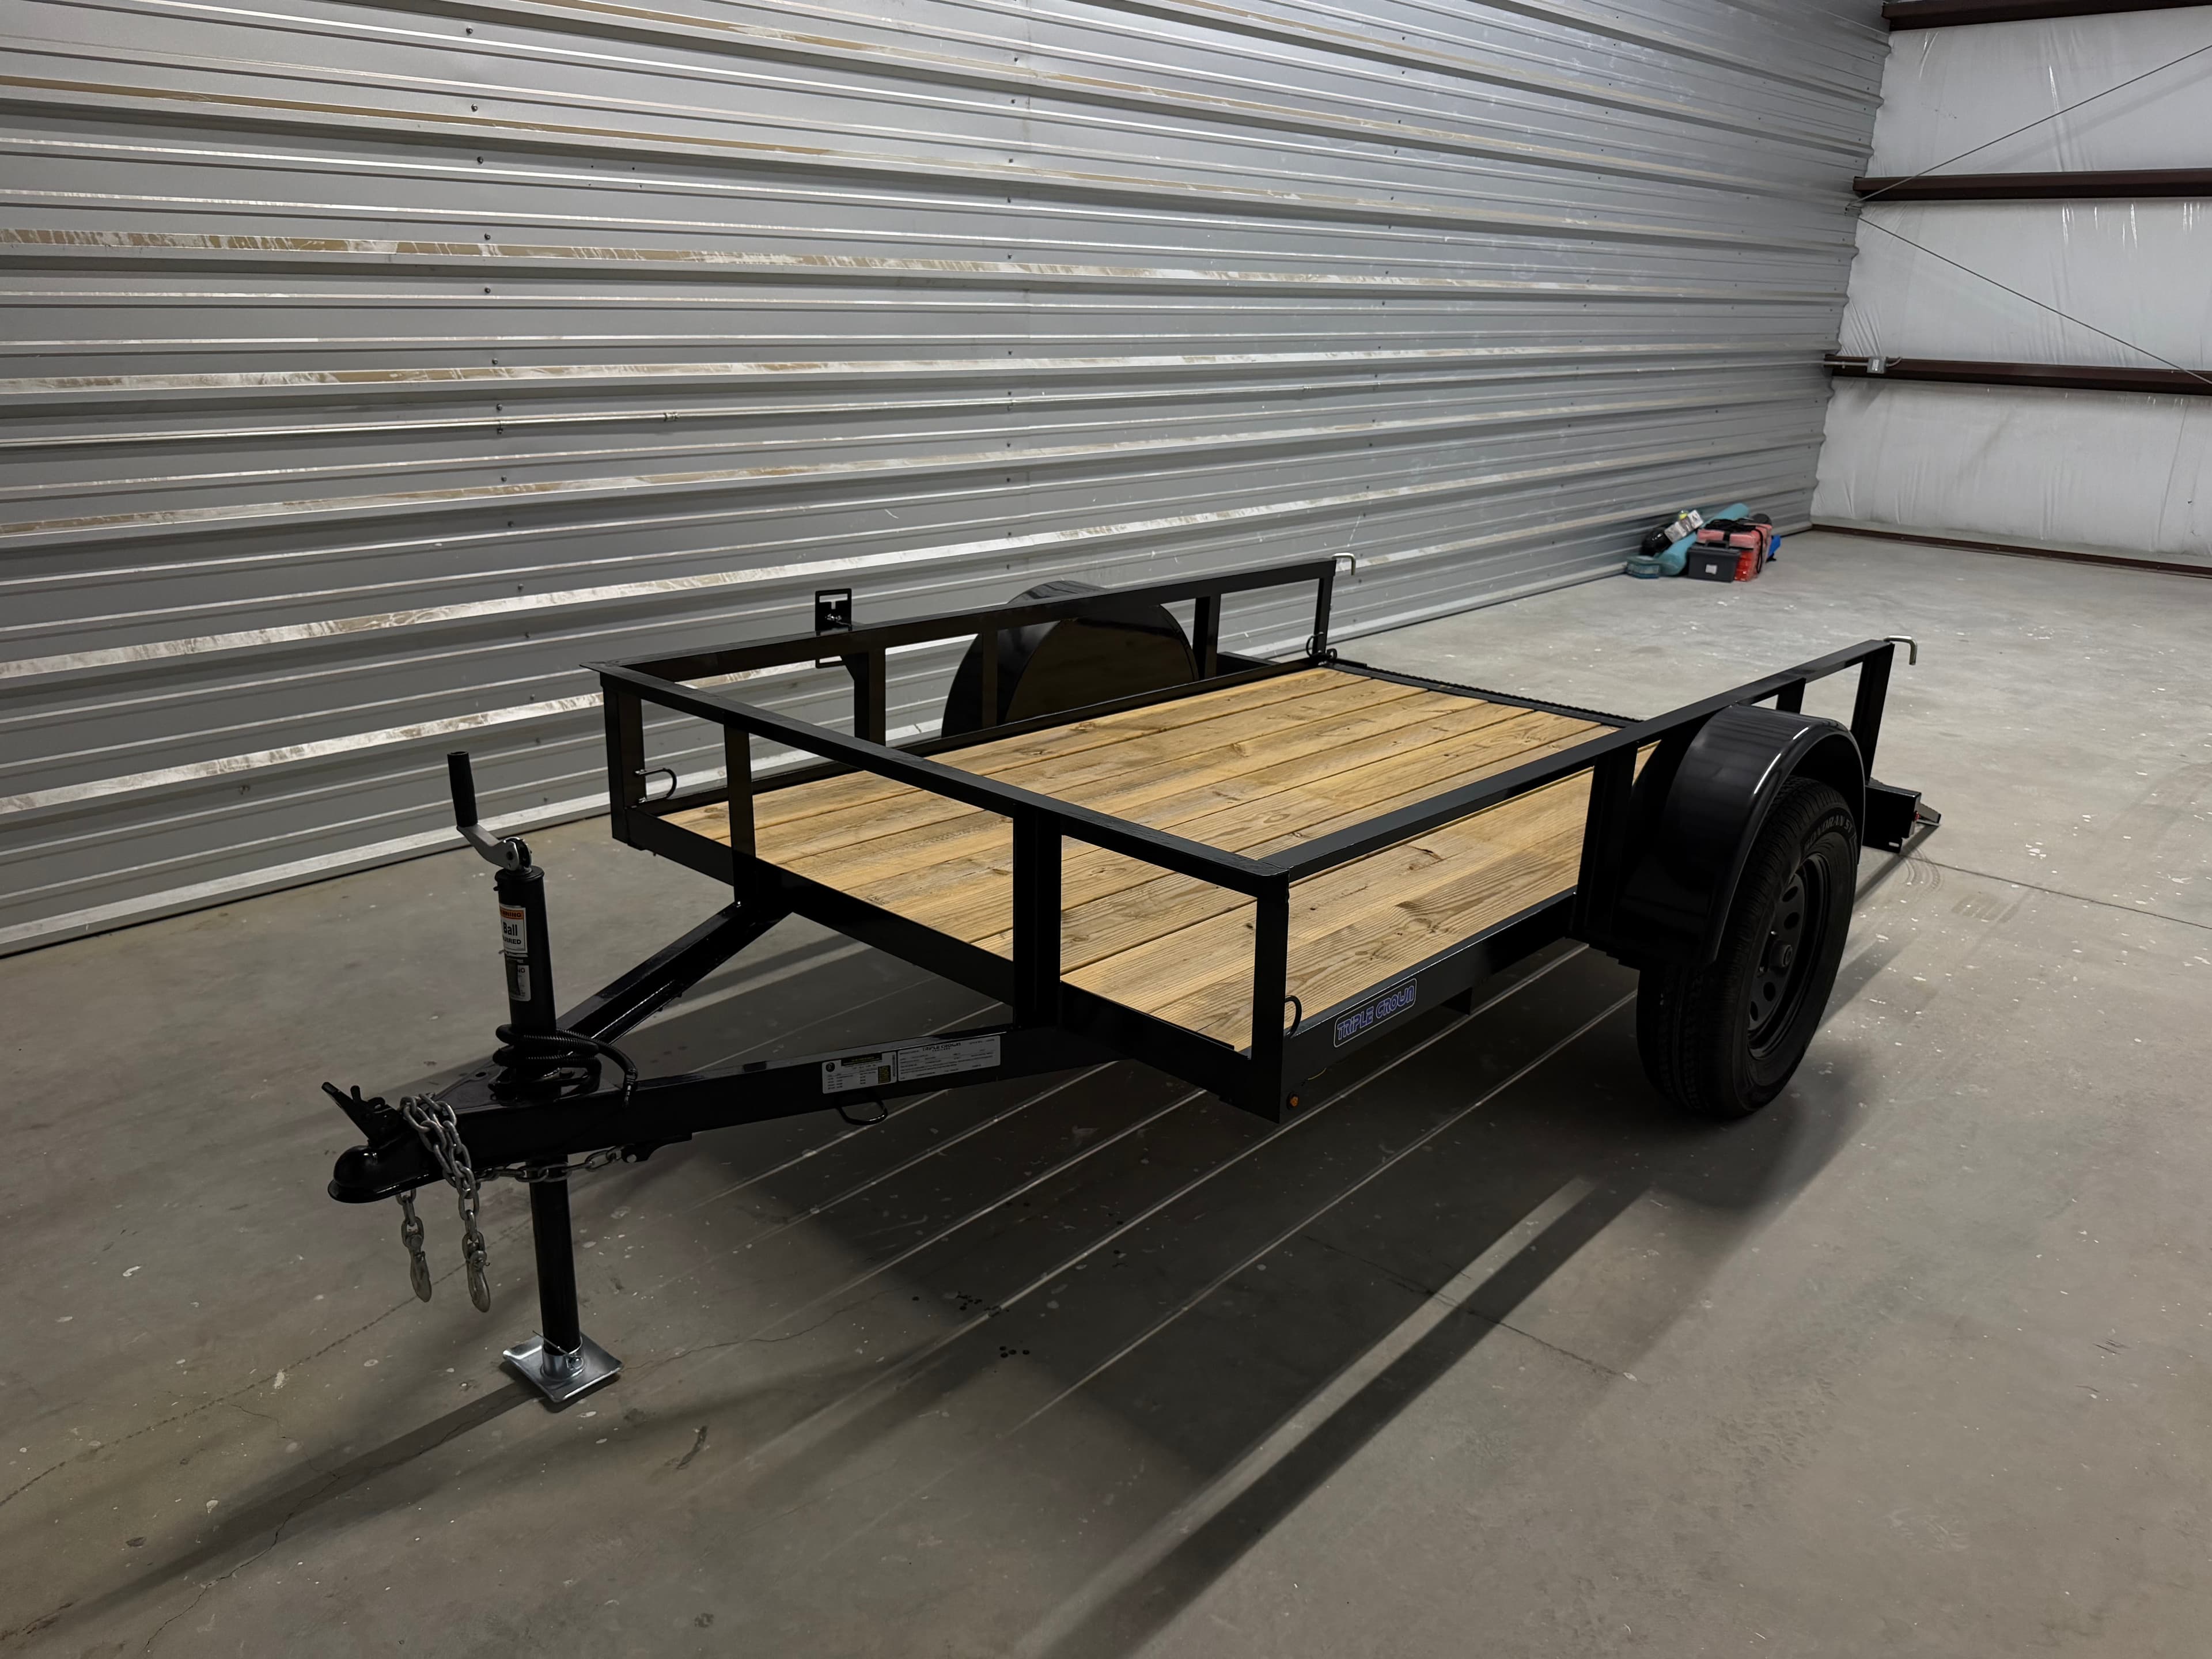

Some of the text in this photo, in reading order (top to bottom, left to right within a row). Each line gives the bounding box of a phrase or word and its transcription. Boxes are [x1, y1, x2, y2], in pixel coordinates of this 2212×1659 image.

[503, 922, 518, 936] Ball
[1337, 985, 1414, 1040] TRIPLE CROWN
